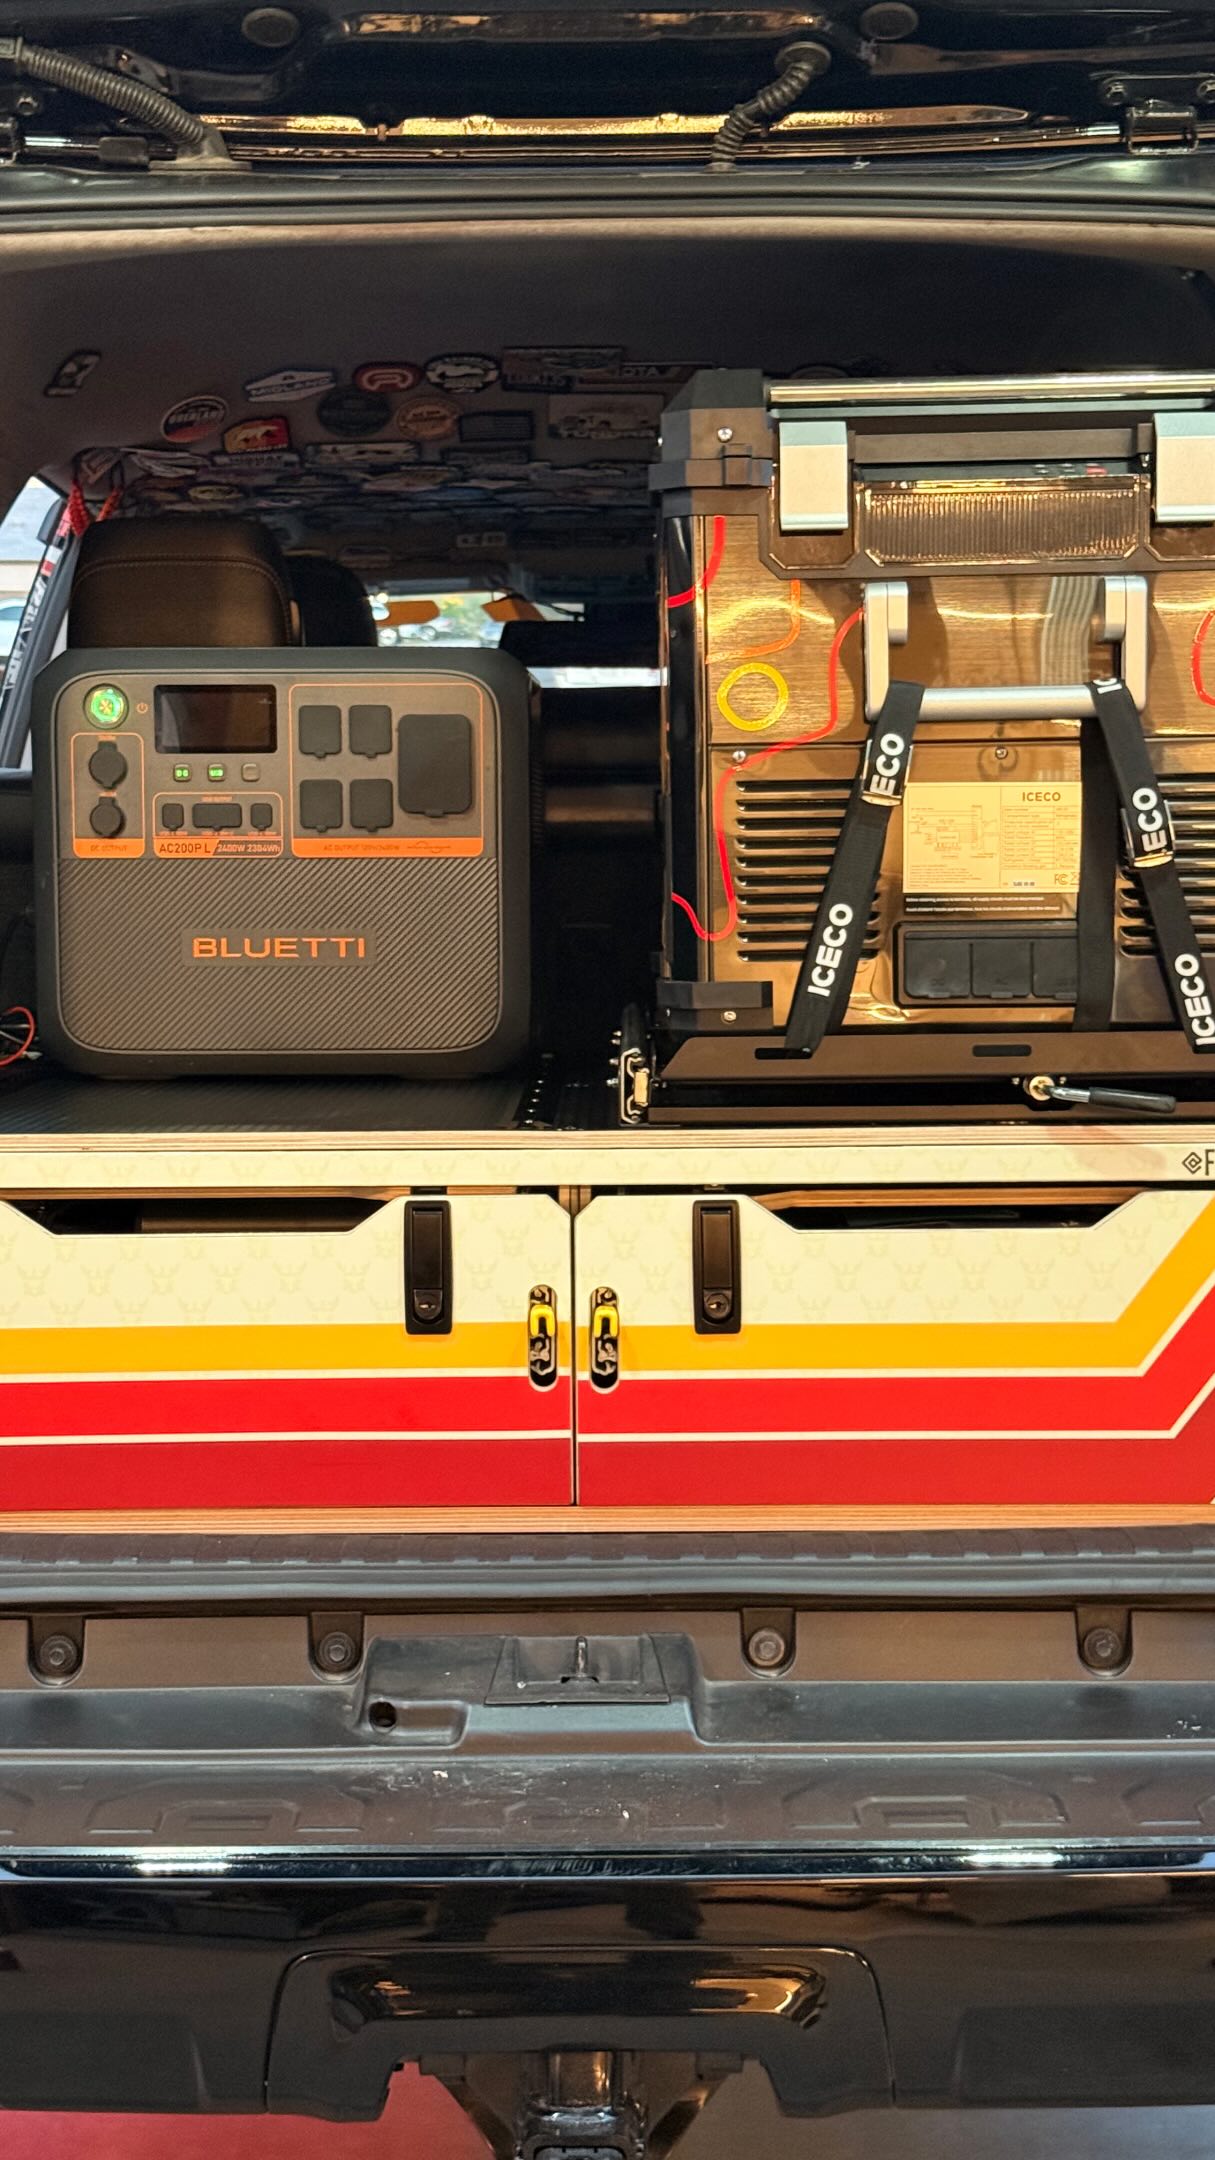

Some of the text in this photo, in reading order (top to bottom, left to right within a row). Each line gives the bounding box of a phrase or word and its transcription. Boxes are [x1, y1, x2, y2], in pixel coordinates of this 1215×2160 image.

[1021, 791, 1062, 802] ICECO
[192, 937, 366, 959] BLUETTI
[807, 903, 854, 998] ICECO
[1174, 953, 1215, 1046] ICECO
